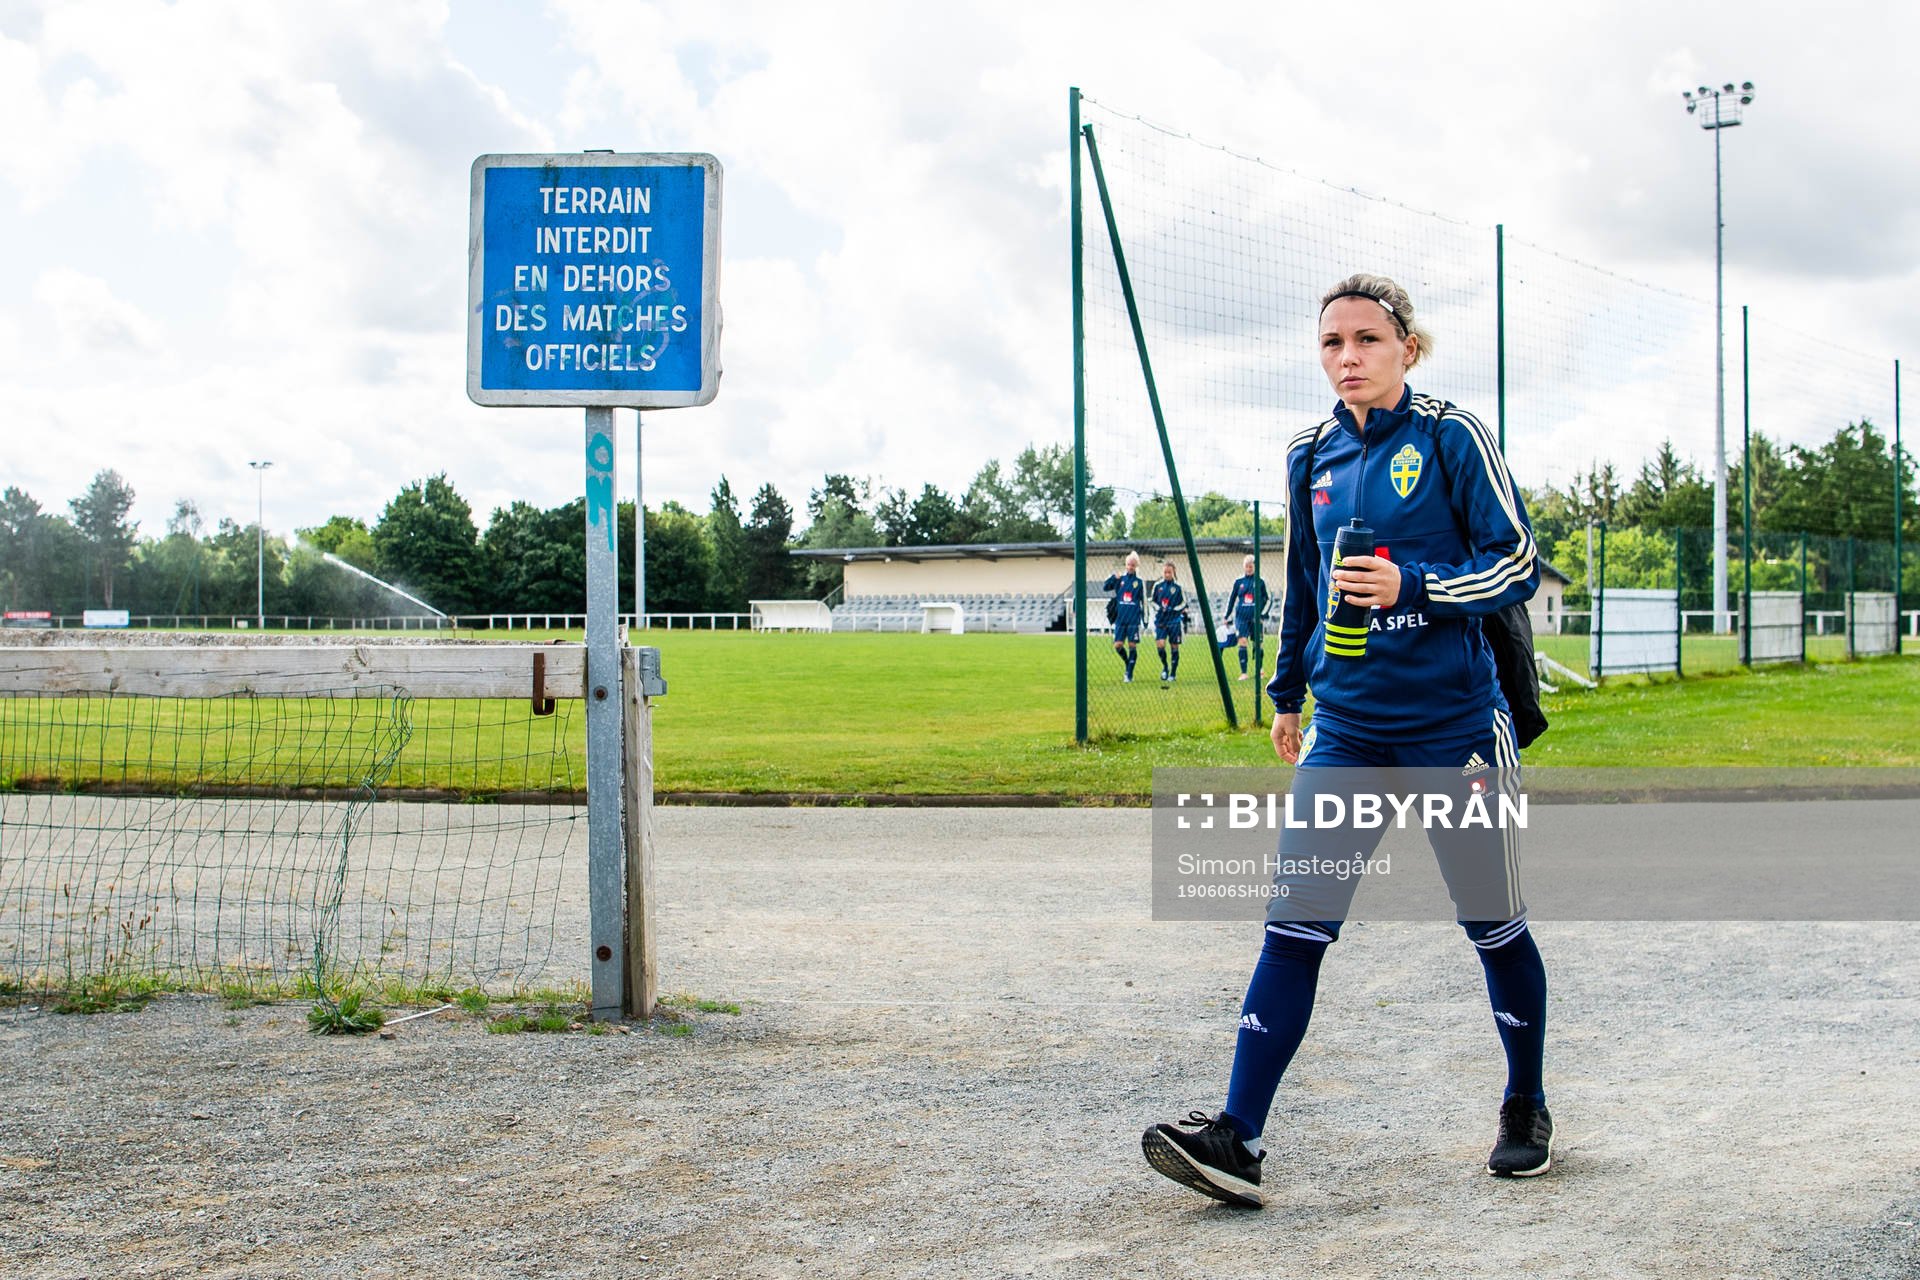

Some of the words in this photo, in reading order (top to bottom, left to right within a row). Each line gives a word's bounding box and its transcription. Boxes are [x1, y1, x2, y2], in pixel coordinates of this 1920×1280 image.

[536, 227, 652, 254] INTERDIT
[514, 265, 548, 292] EN
[563, 264, 672, 292] DEHORS
[495, 304, 548, 331] DES
[562, 304, 687, 332] MATCHES
[525, 343, 656, 371] OFFICIELS
[1386, 613, 1429, 631] SPEL
[1461, 762, 1490, 777] adidas
